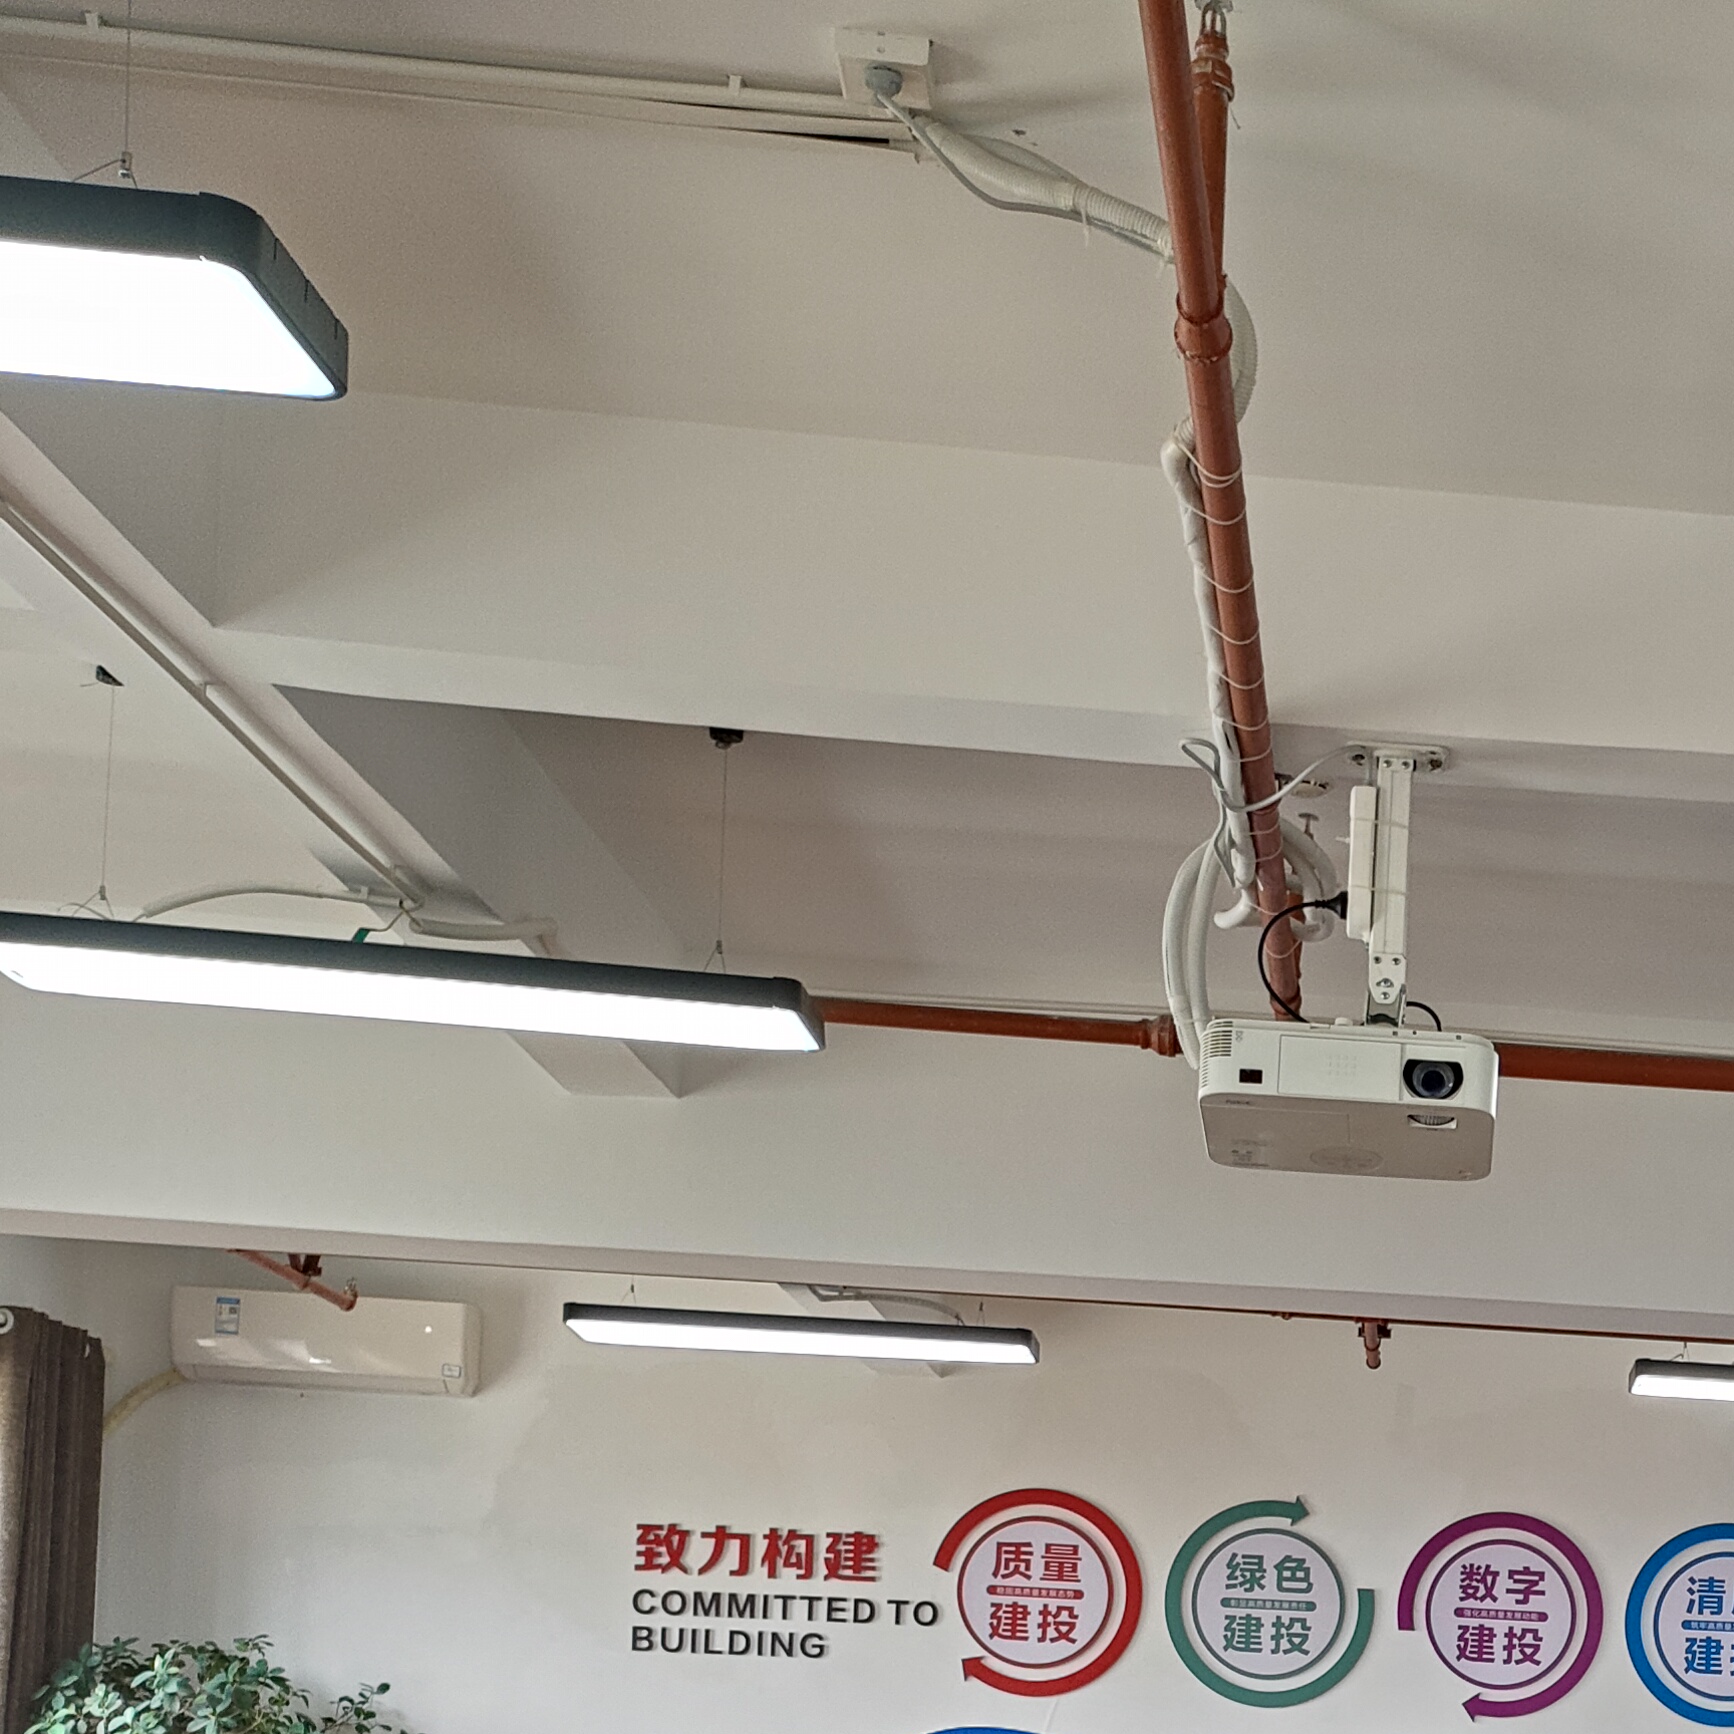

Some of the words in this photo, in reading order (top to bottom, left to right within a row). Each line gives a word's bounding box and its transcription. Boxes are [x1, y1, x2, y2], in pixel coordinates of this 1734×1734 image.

[633, 1522, 881, 1583] 致力构建
[992, 1541, 1082, 1583] 质量
[1225, 1552, 1314, 1594] 绿色
[1458, 1563, 1546, 1605] 数字
[631, 1588, 877, 1625] COMMITTED
[886, 1599, 940, 1627] TO
[988, 1601, 1079, 1645] 建投
[630, 1625, 828, 1659] BUILDING
[1223, 1613, 1312, 1656] 建投
[1456, 1623, 1543, 1666] 建投
